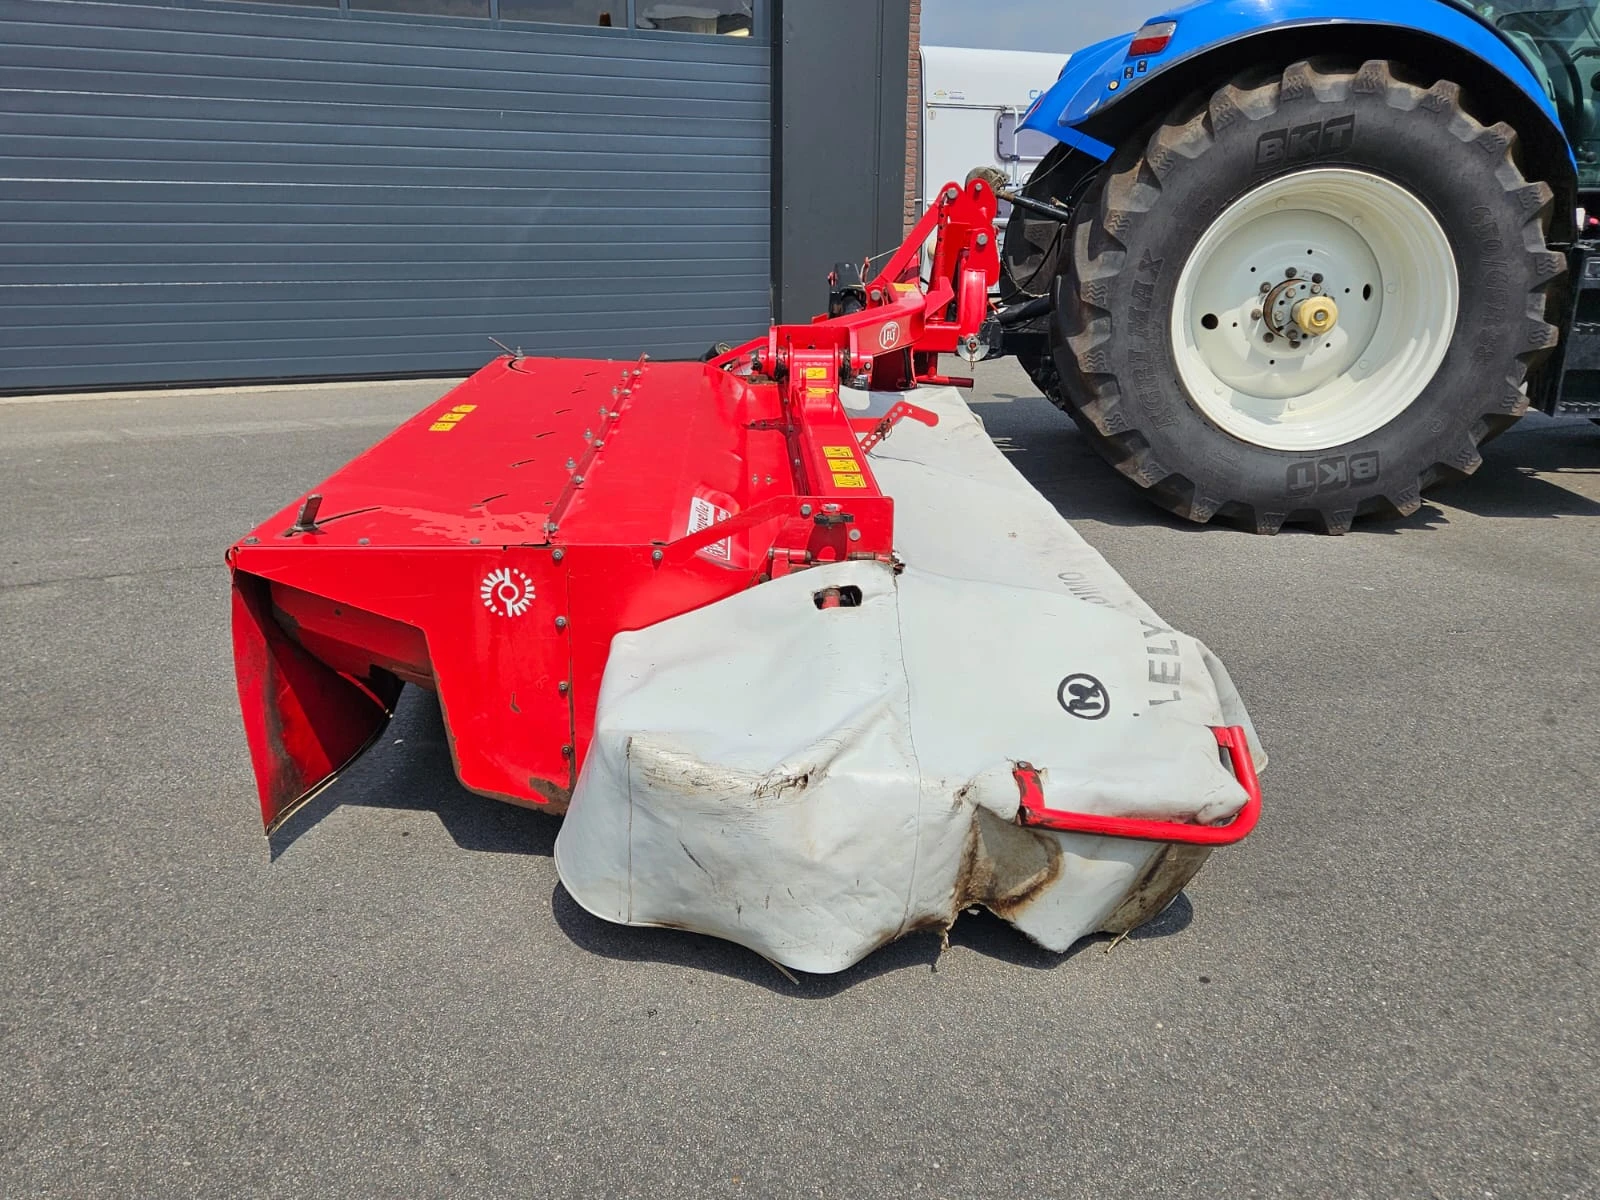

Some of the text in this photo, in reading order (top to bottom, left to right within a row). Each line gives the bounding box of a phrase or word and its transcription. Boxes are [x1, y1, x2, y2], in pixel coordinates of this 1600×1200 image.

[1257, 119, 1353, 164] BKT
[1287, 454, 1378, 492] BKT
[1139, 619, 1182, 706] LELY
